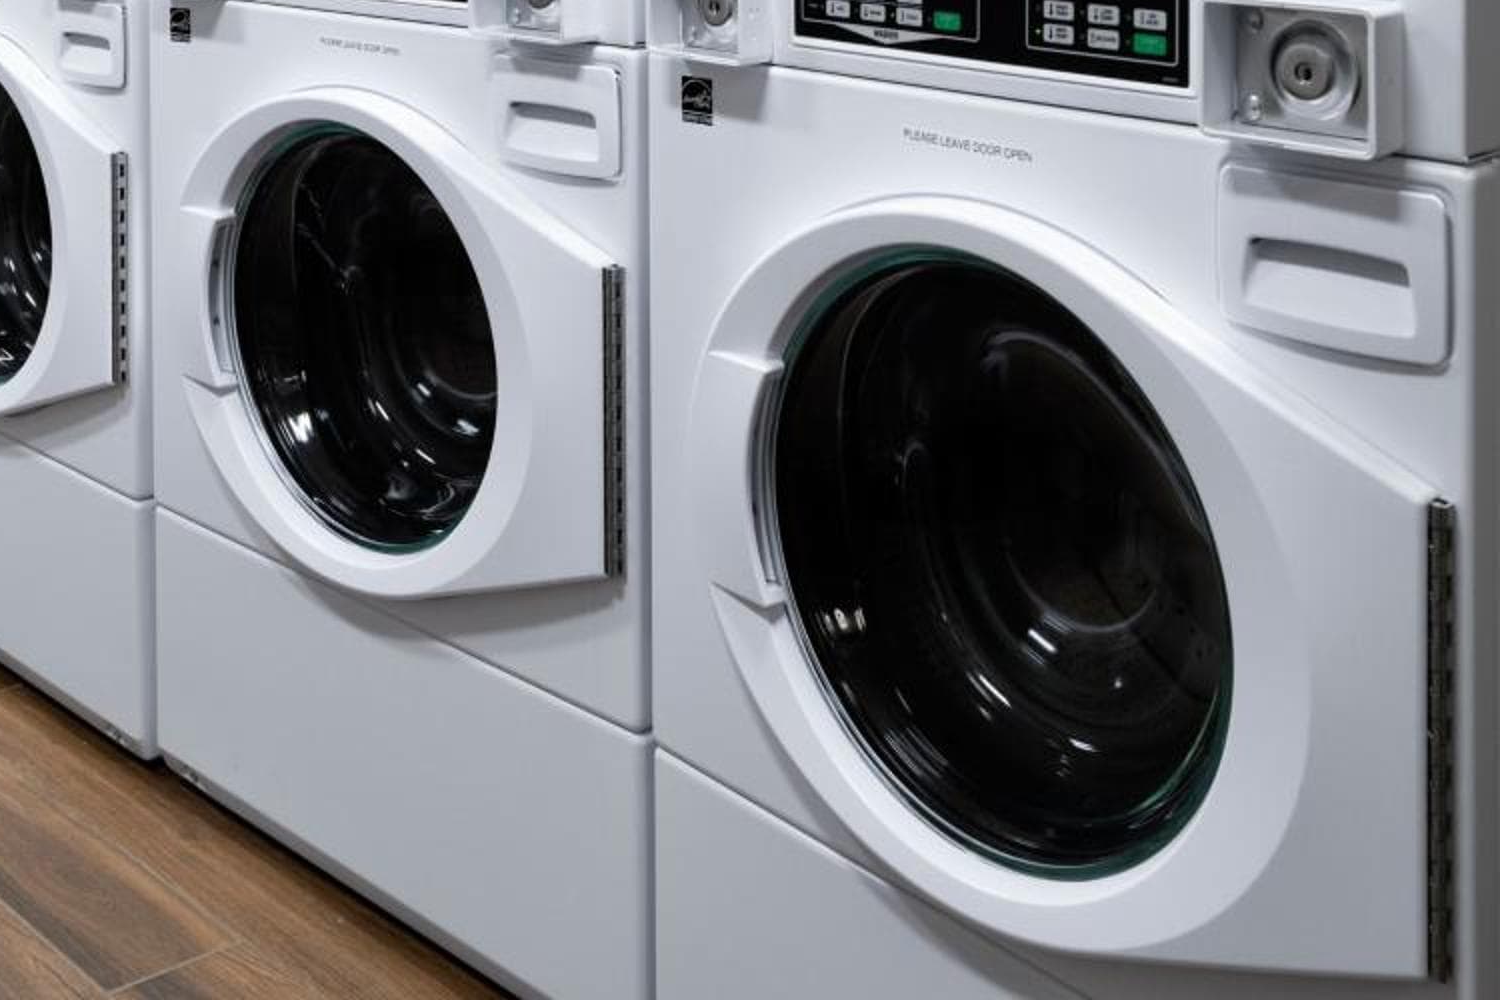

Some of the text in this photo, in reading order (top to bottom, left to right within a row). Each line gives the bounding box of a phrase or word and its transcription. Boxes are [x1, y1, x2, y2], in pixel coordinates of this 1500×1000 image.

[903, 127, 1033, 162] PLEASE LEAVE DOOR OPEN
